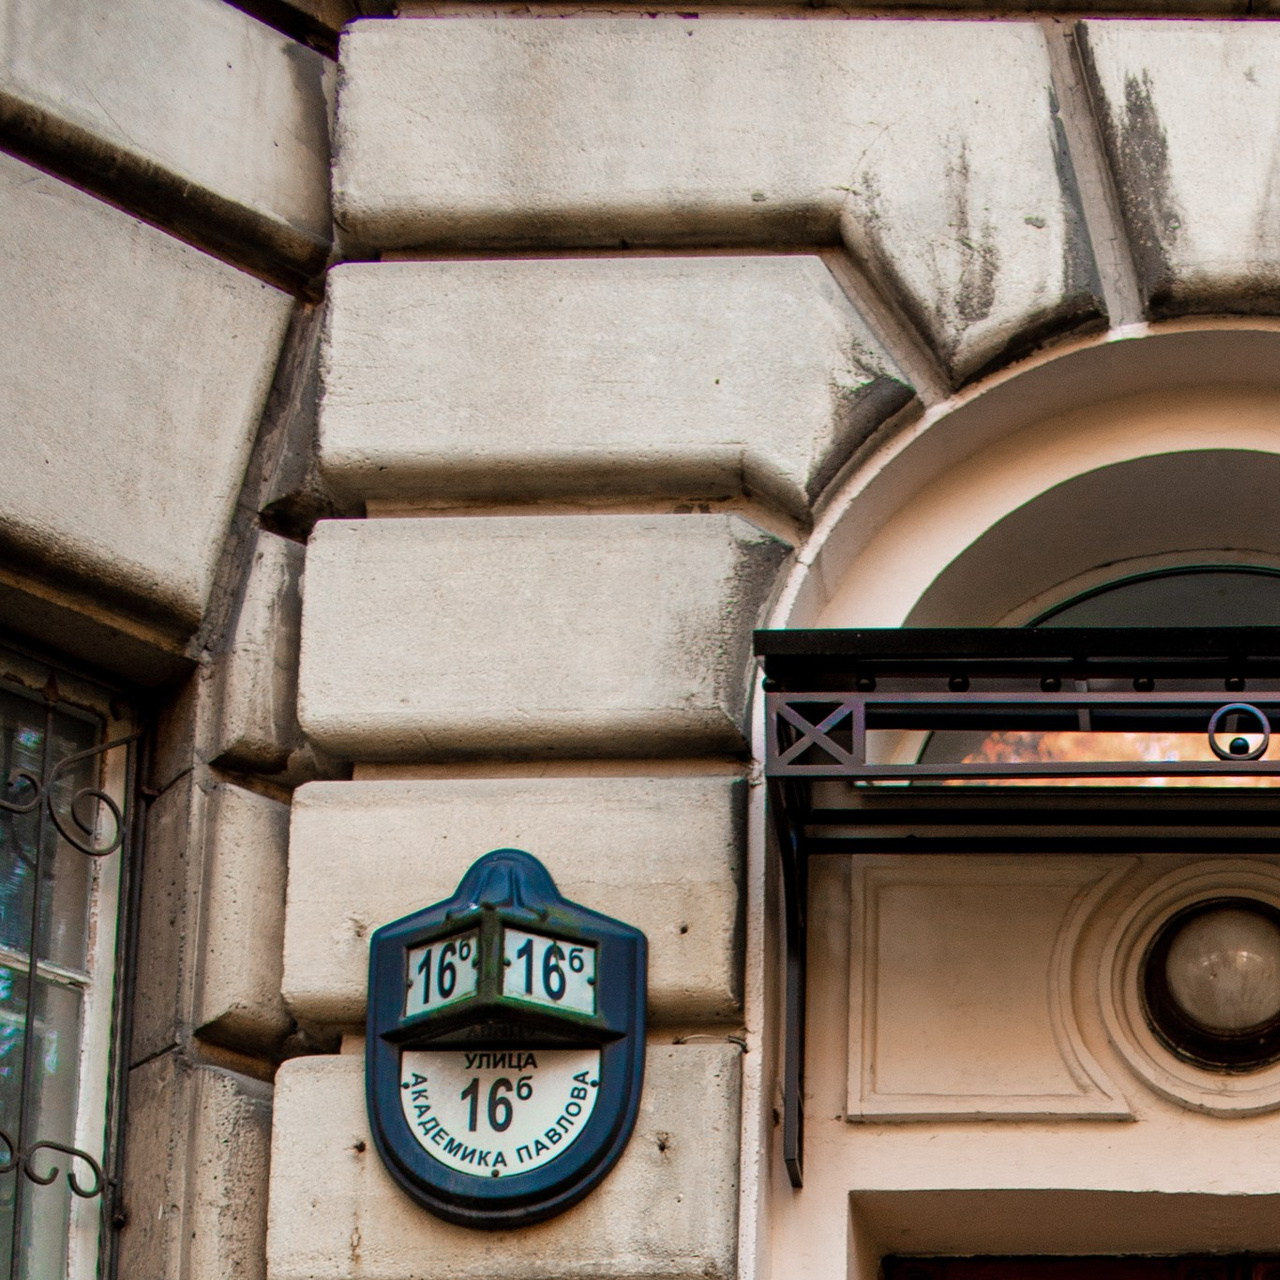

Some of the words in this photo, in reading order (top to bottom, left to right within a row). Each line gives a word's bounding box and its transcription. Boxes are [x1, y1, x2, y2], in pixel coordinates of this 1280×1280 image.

[465, 1052, 538, 1071] УЛИЦА
[411, 1072, 507, 1167] АКАДЕМИКА
[516, 1070, 589, 1163] ПАВЛОВА
